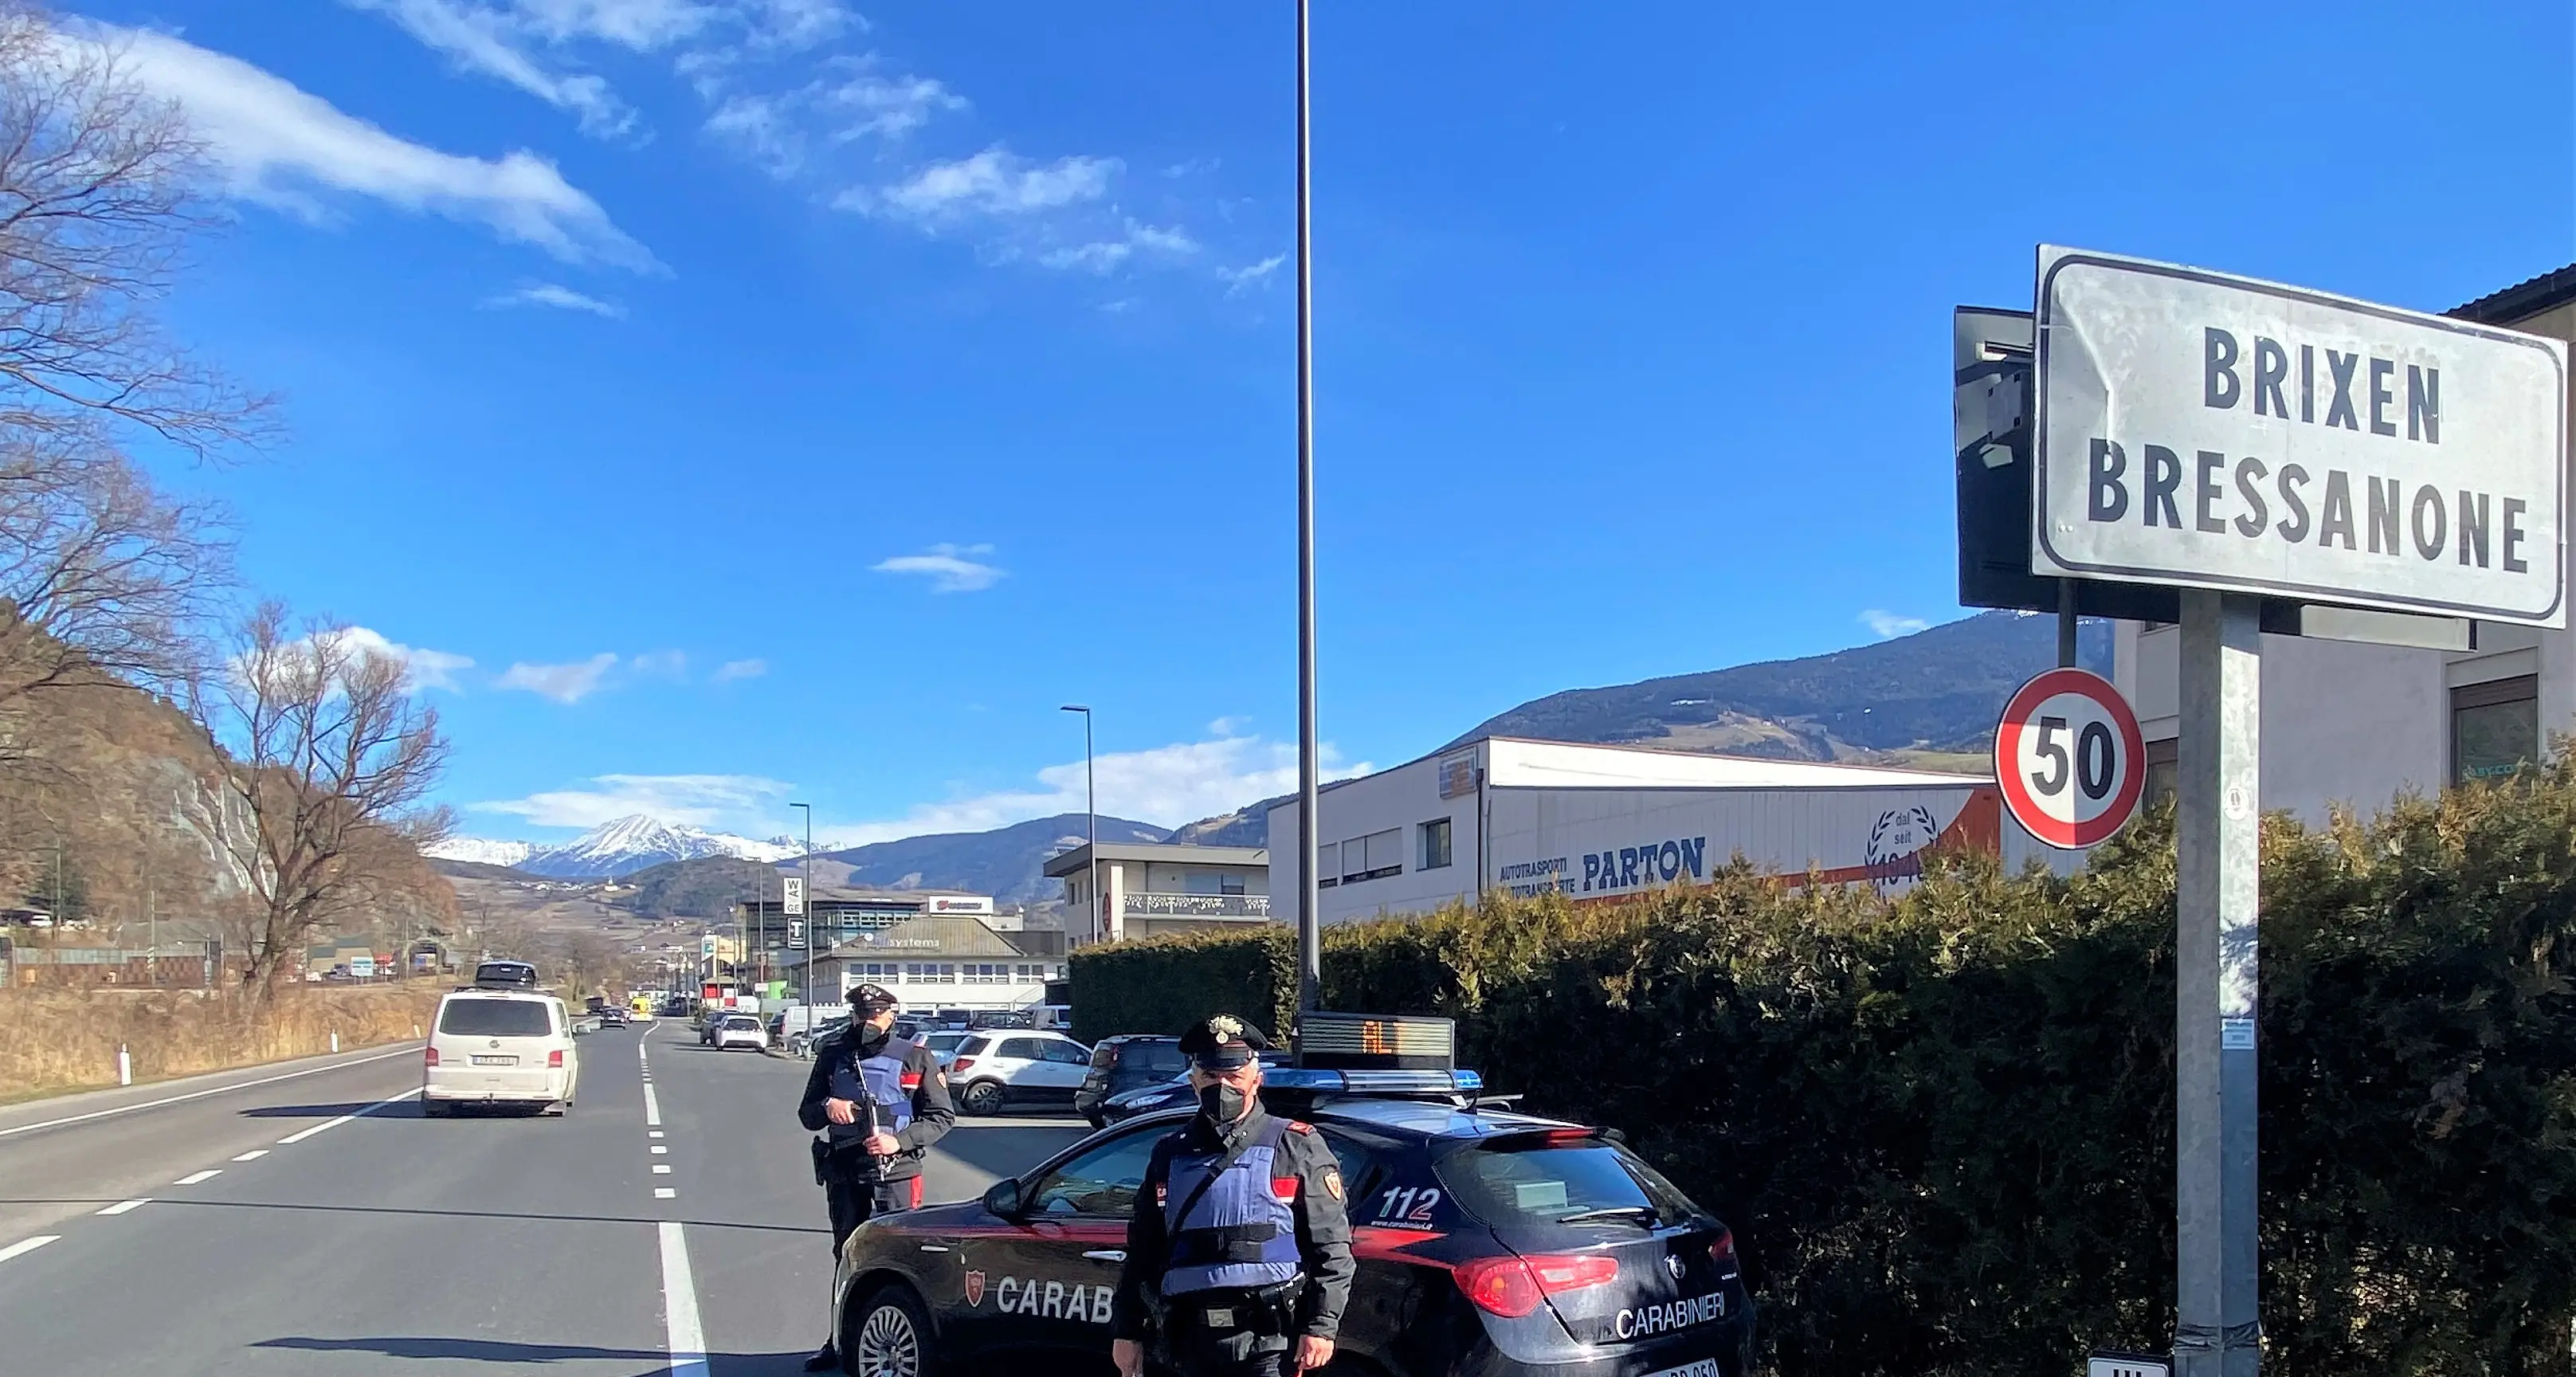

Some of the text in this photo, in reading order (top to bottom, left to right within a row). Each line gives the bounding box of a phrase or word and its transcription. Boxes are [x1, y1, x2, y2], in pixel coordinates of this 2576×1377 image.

[2205, 327, 2439, 444] BRIXEN
[2088, 437, 2527, 574] BRESSANONE
[2031, 716, 2115, 799] 50
[1894, 830, 1911, 845] seit
[1896, 812, 1911, 826] dal
[1500, 857, 1567, 882] AUTOTRASPORTI
[1583, 836, 1706, 892] PARTON
[889, 936, 939, 947] systems
[1379, 1186, 1441, 1220] 112
[997, 1276, 1115, 1324] CARAB
[1616, 1291, 1725, 1339] CARABINIERI
